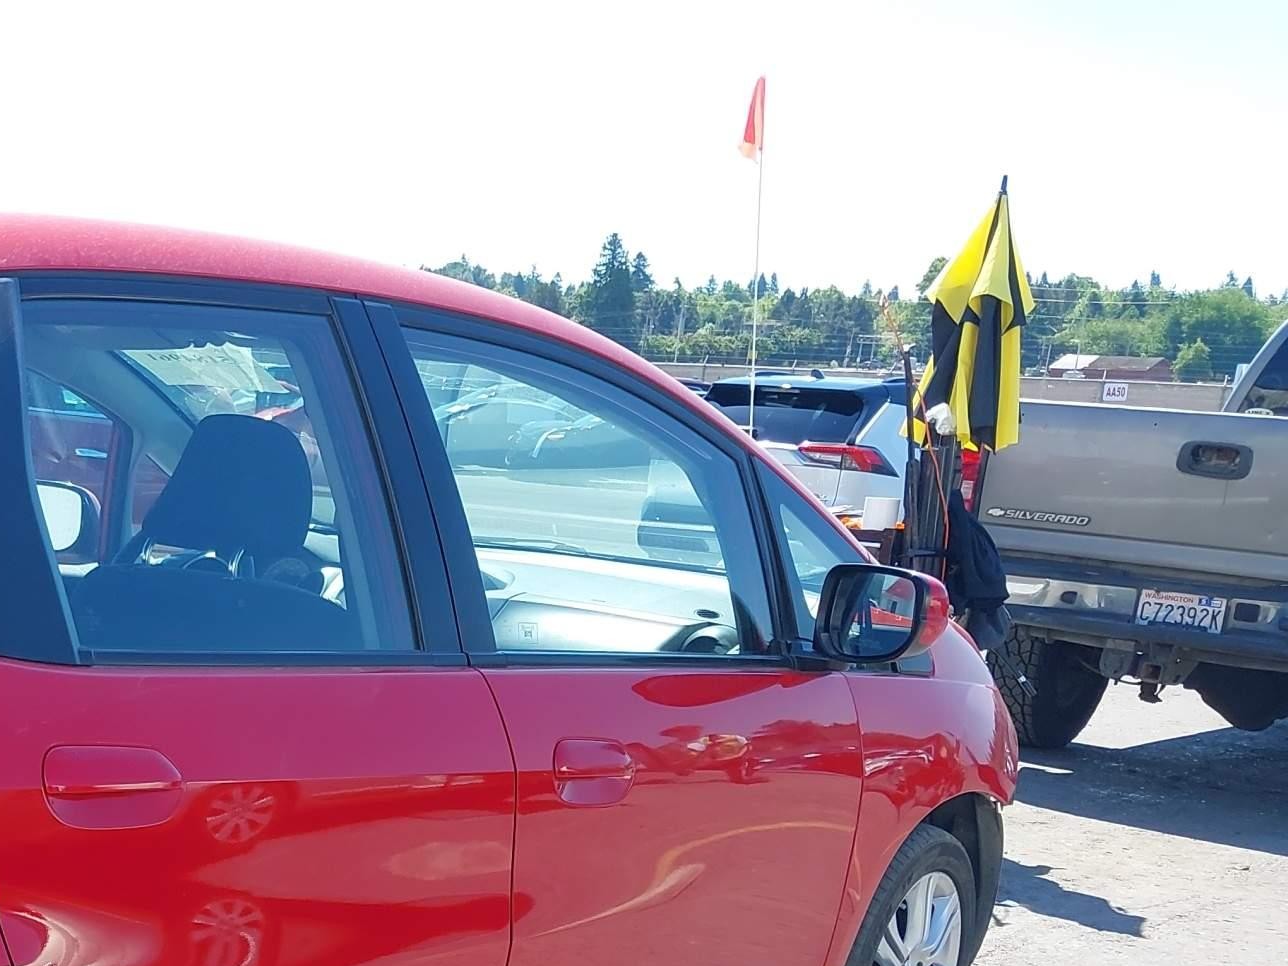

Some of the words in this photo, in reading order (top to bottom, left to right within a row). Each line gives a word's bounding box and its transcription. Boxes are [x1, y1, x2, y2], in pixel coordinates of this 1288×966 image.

[1106, 386, 1126, 398] AA50
[1004, 509, 1089, 525] SILVERADO
[1145, 592, 1194, 603] WASHINGTON
[1140, 602, 1222, 631] C72392K
